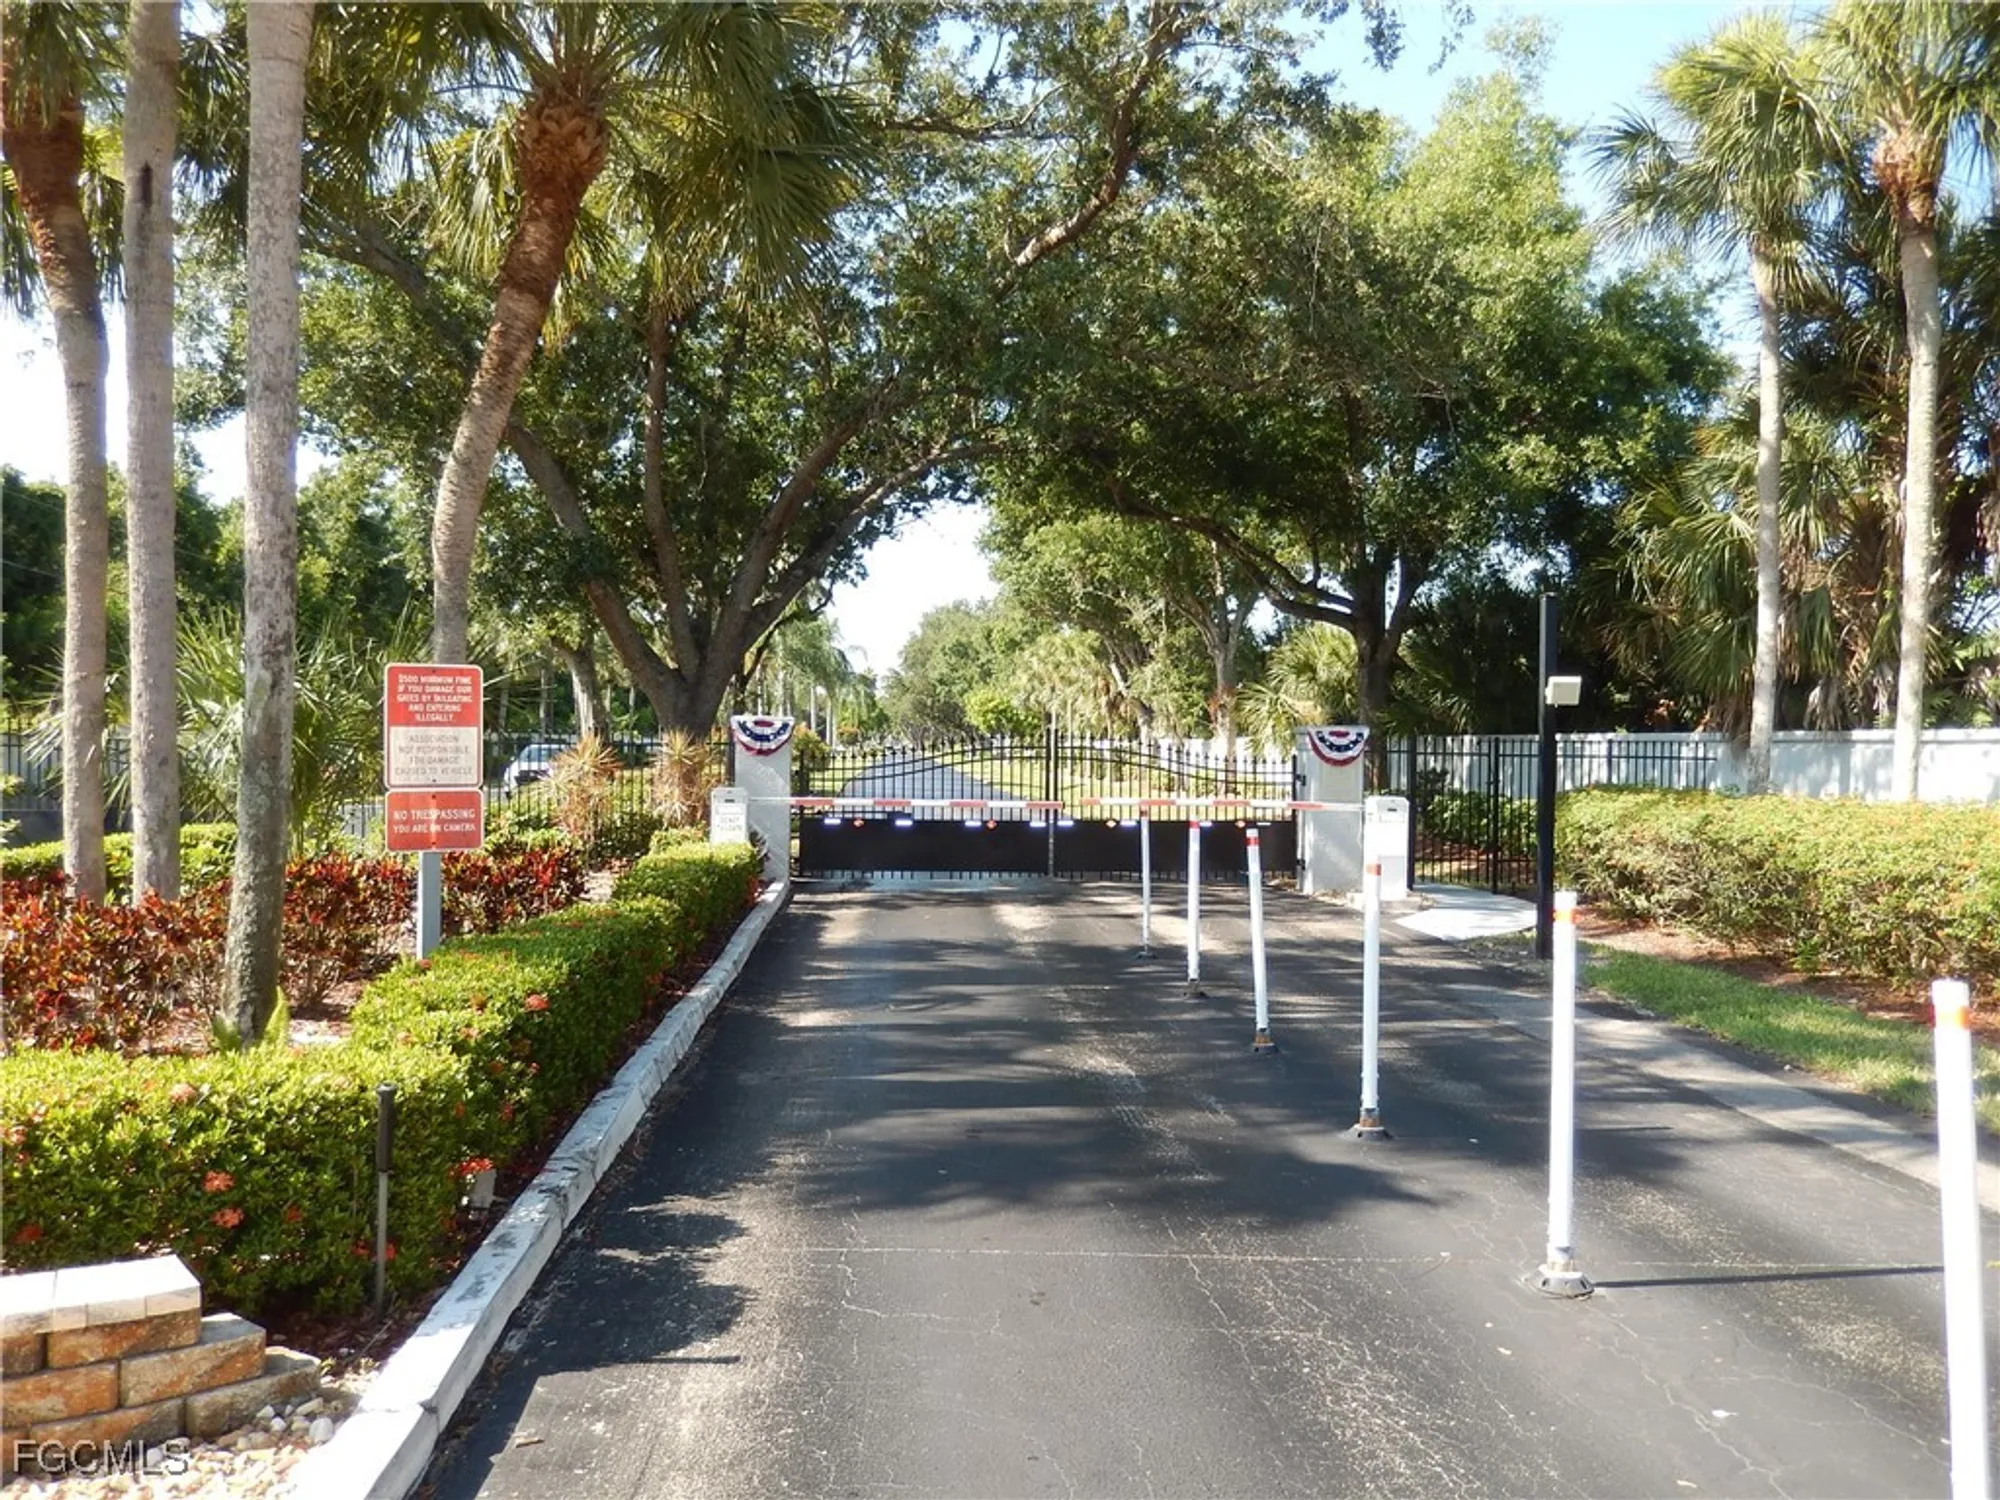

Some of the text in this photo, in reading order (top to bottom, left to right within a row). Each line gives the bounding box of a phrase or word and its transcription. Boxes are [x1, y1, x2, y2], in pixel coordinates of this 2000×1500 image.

[420, 675, 454, 684] MINIMUM
[455, 676, 472, 684] FINE
[398, 684, 472, 694] IF YOU DAMAGE OUR
[397, 693, 419, 702] GATES
[422, 694, 432, 702] BY
[408, 704, 462, 712] AND ENTERING
[393, 808, 476, 820] NO TRESPASSING
[393, 824, 410, 833] YOU
[412, 824, 428, 833] ARE
[443, 823, 476, 832] CAMERA
